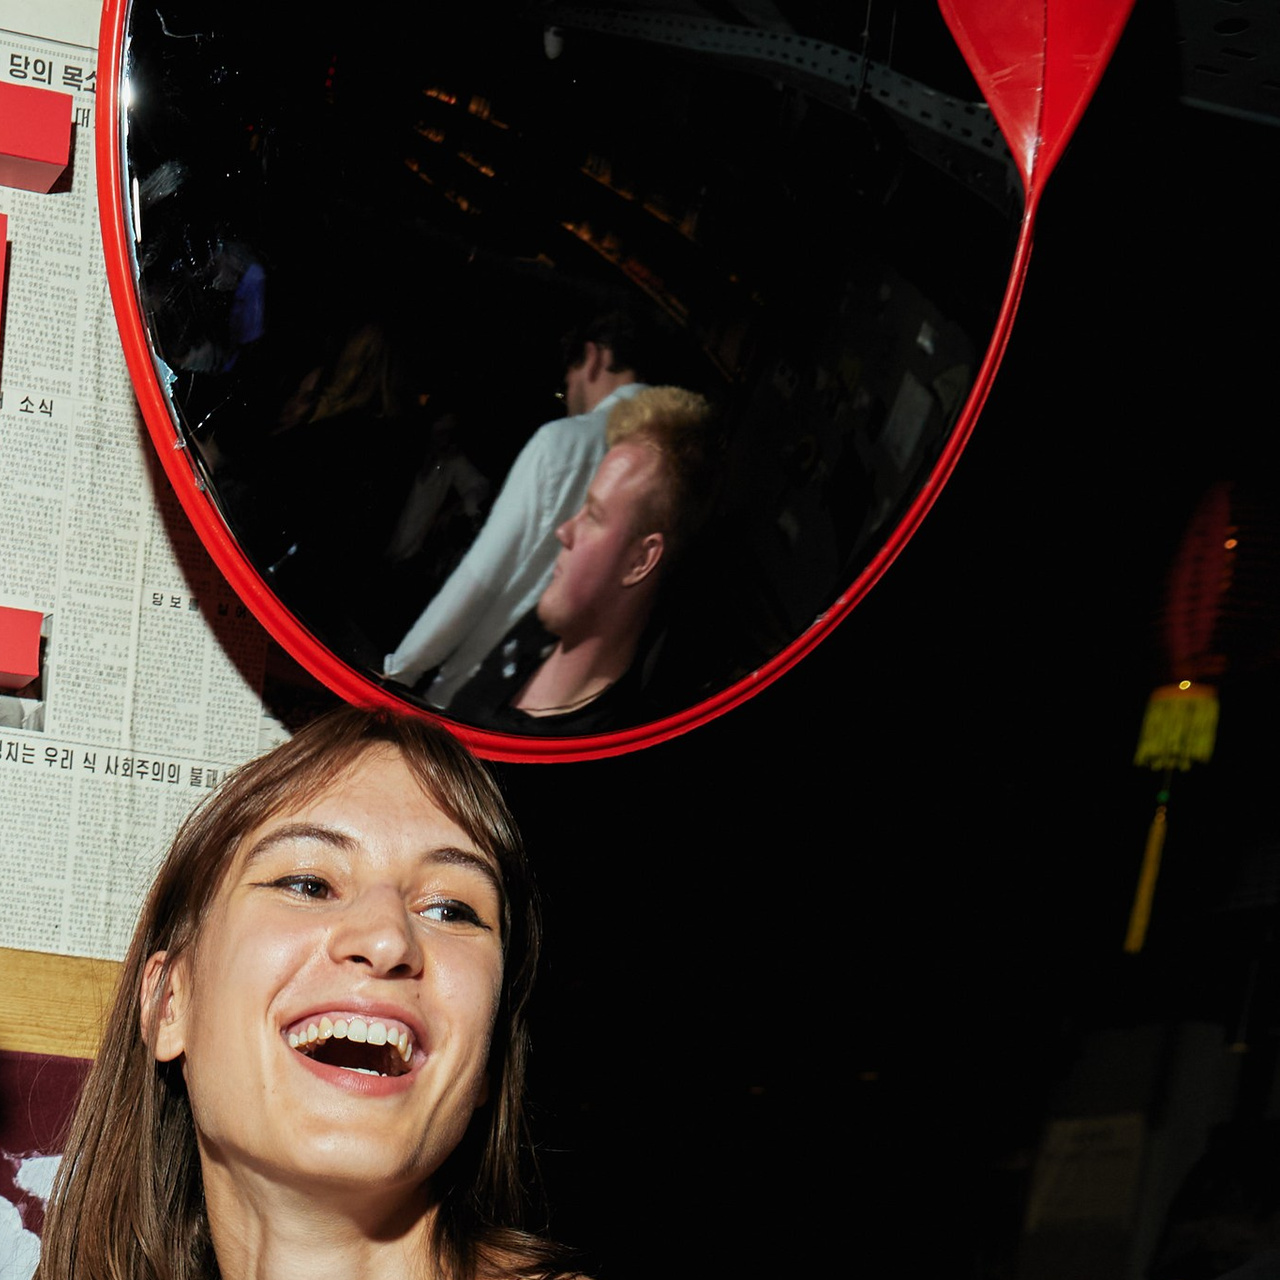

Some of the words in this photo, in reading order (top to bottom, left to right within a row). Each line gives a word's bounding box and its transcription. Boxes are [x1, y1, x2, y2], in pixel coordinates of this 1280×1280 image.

[9, 53, 53, 85] 당의
[19, 395, 54, 418] 소식
[44, 746, 74, 770] 우리
[82, 753, 96, 773] 식
[105, 755, 181, 784] 사회주의의
